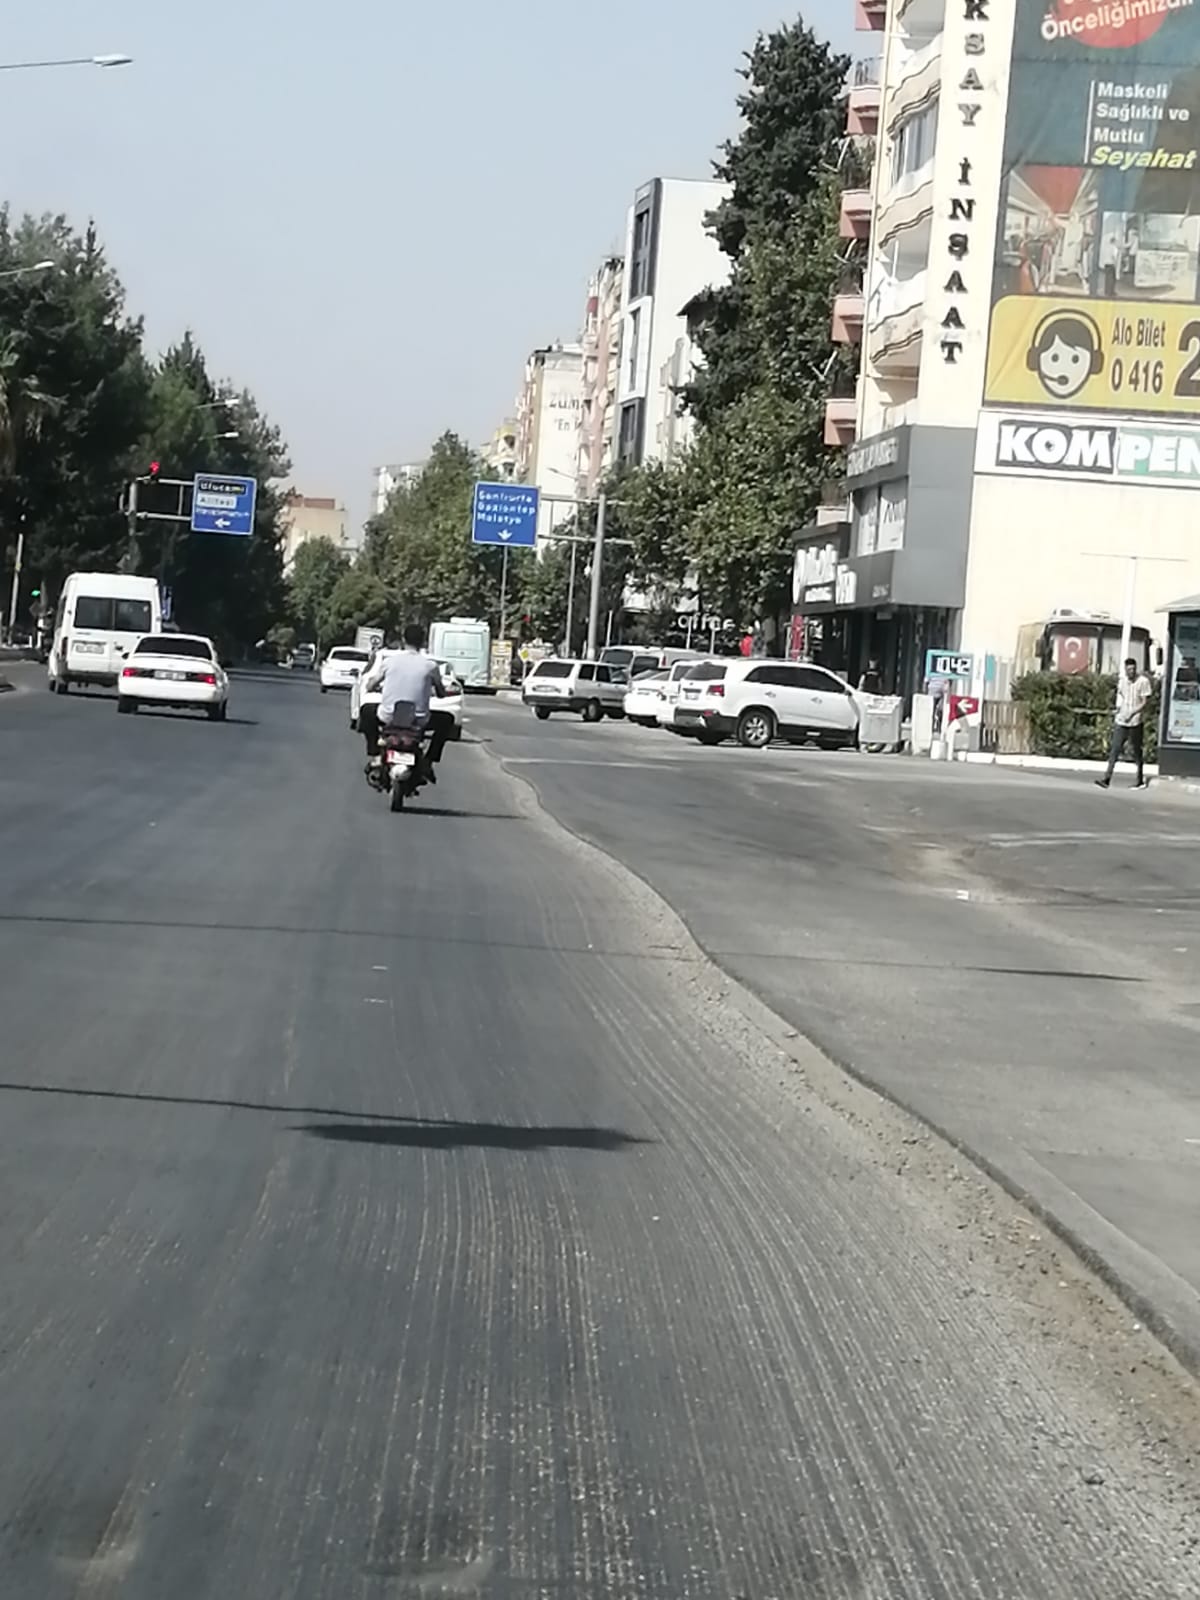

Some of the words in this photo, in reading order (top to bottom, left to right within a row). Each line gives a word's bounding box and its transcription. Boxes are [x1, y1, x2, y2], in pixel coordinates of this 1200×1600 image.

[1097, 82, 1168, 99] Maskeli
[1096, 102, 1163, 122] Sağlıklı
[1168, 108, 1190, 121] ve
[1093, 127, 1144, 143] Mutlu
[1091, 145, 1198, 171] Seyahat
[1111, 316, 1132, 346] Alo
[1136, 317, 1166, 348] Bilet
[1111, 357, 1123, 392] 0
[1128, 359, 1164, 394] 416
[477, 511, 522, 525] Malatya
